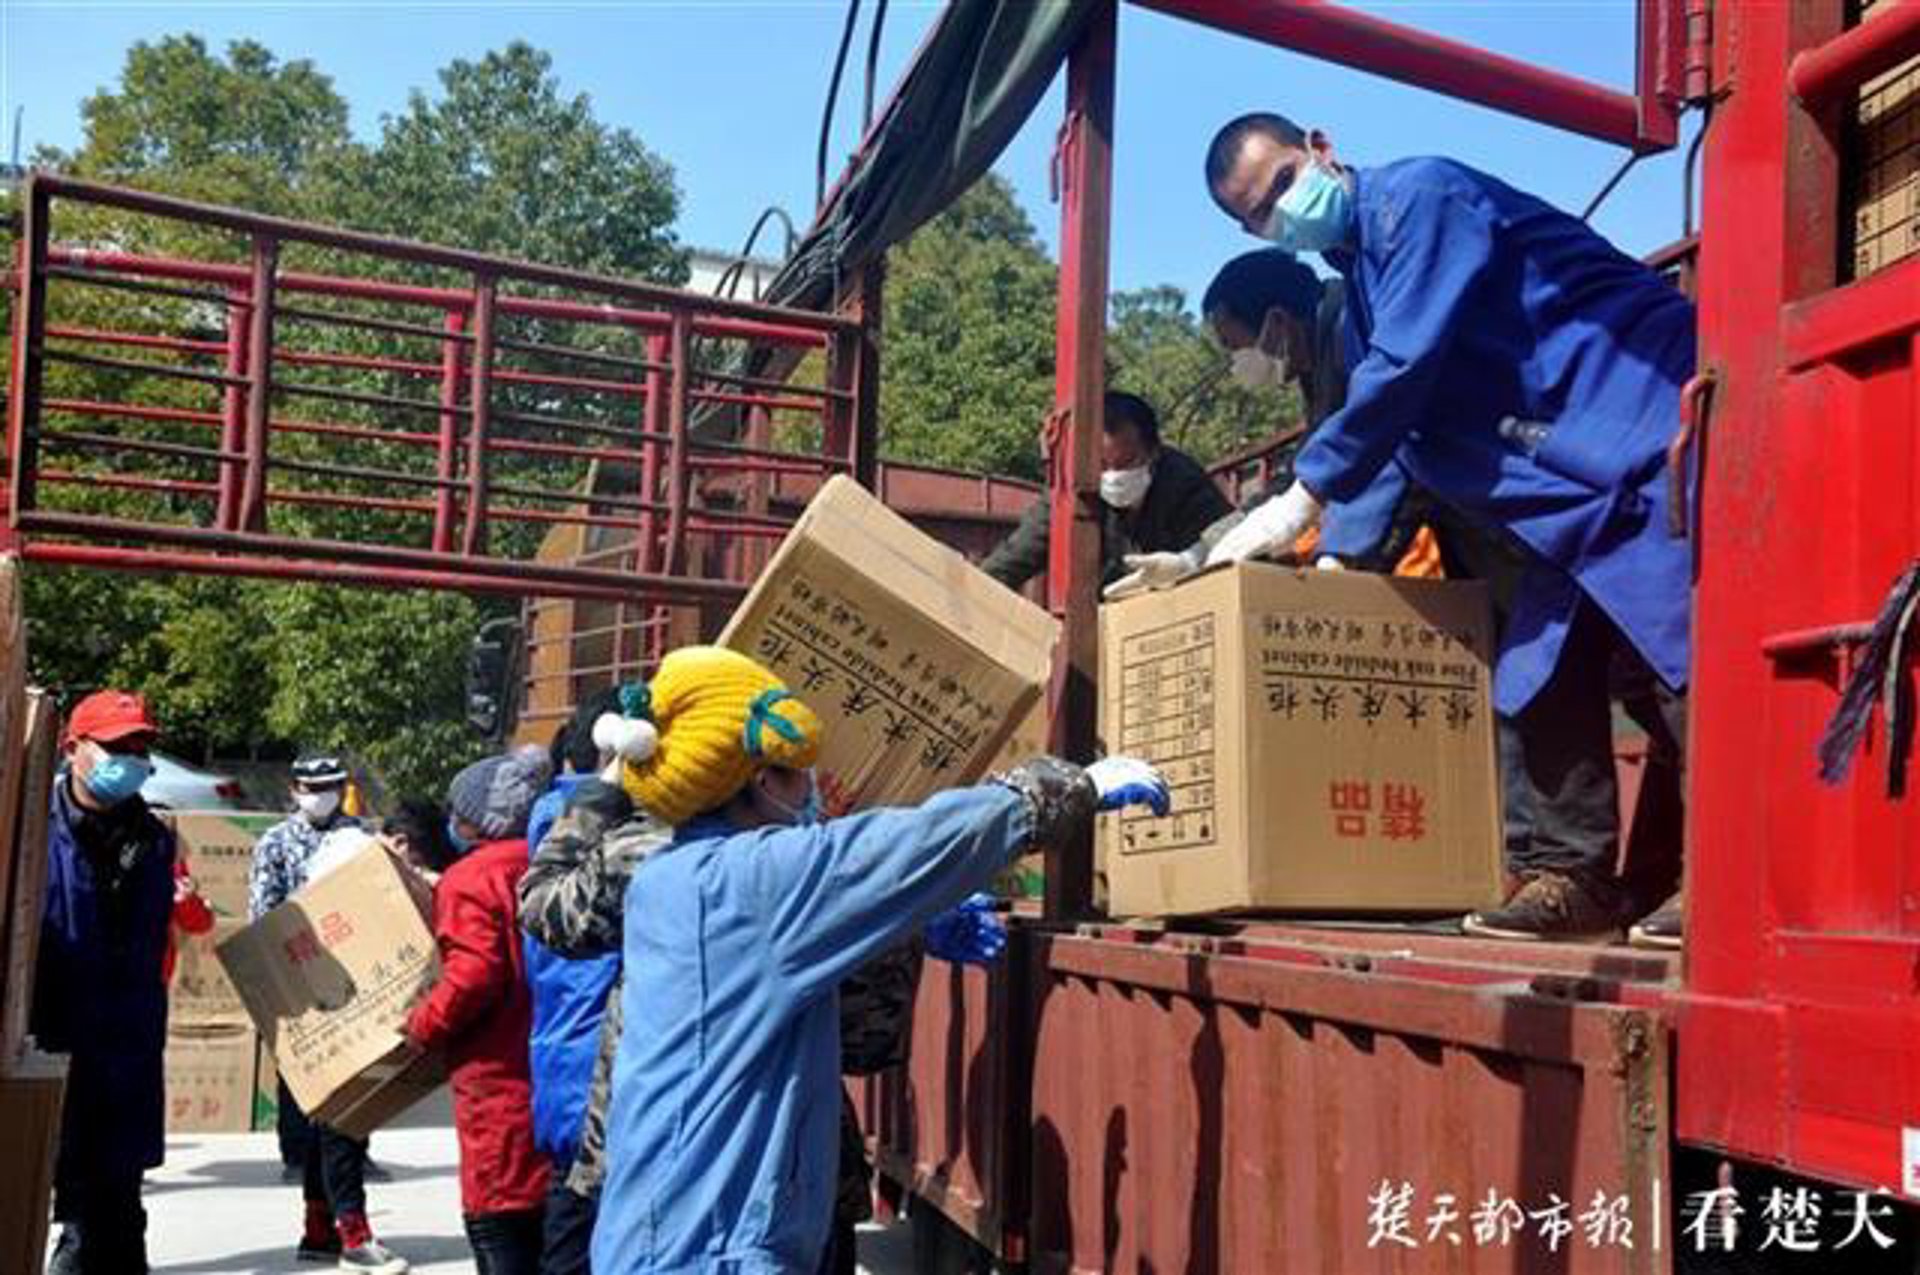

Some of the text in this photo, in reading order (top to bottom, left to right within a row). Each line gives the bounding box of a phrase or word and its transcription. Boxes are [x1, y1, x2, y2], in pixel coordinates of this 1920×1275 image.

[759, 635, 959, 772] 橡木床头柜
[1265, 682, 1474, 730] 橡木床头柜
[1331, 780, 1424, 840] 精品
